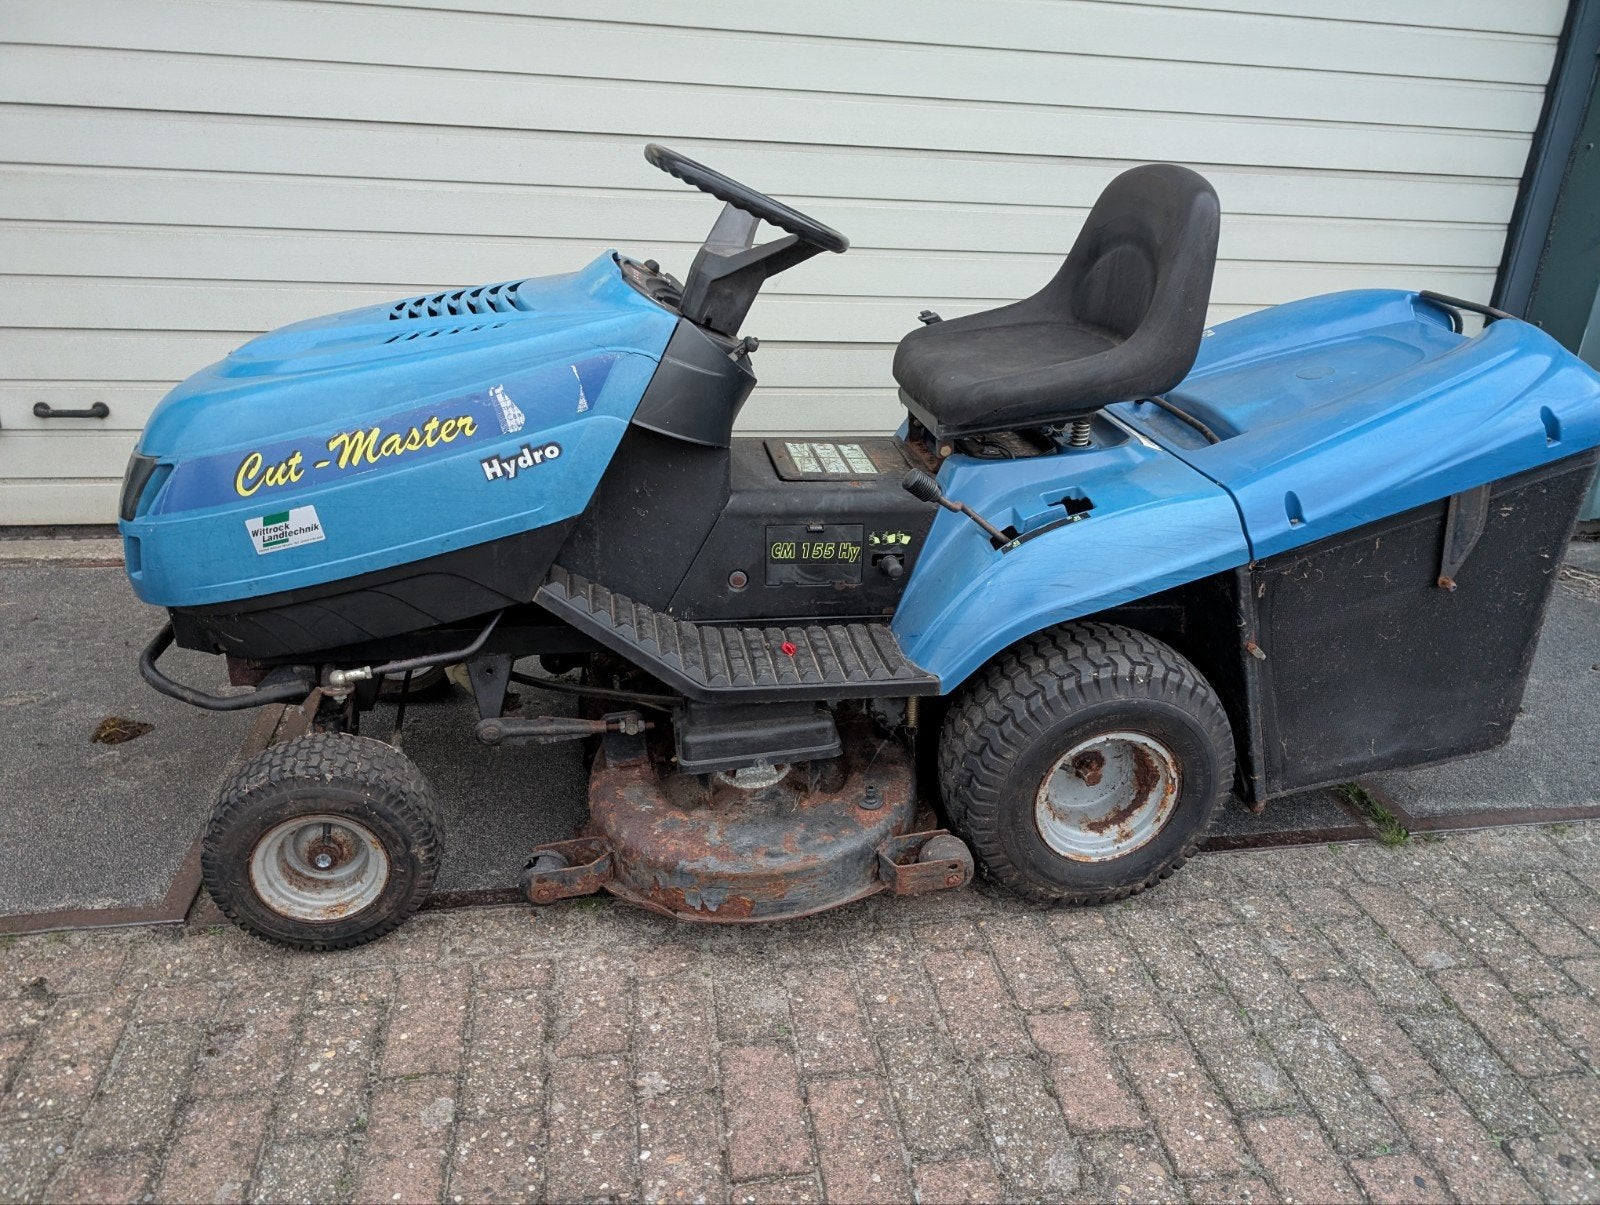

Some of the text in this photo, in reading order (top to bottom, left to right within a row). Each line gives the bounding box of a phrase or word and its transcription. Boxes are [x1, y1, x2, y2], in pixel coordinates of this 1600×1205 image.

[481, 442, 562, 481] Hydro
[235, 450, 305, 497] Cut
[251, 522, 290, 538] Wittrock
[262, 523, 319, 543] Landtechnik
[802, 542, 835, 559] 155
[837, 542, 861, 563] Hy
